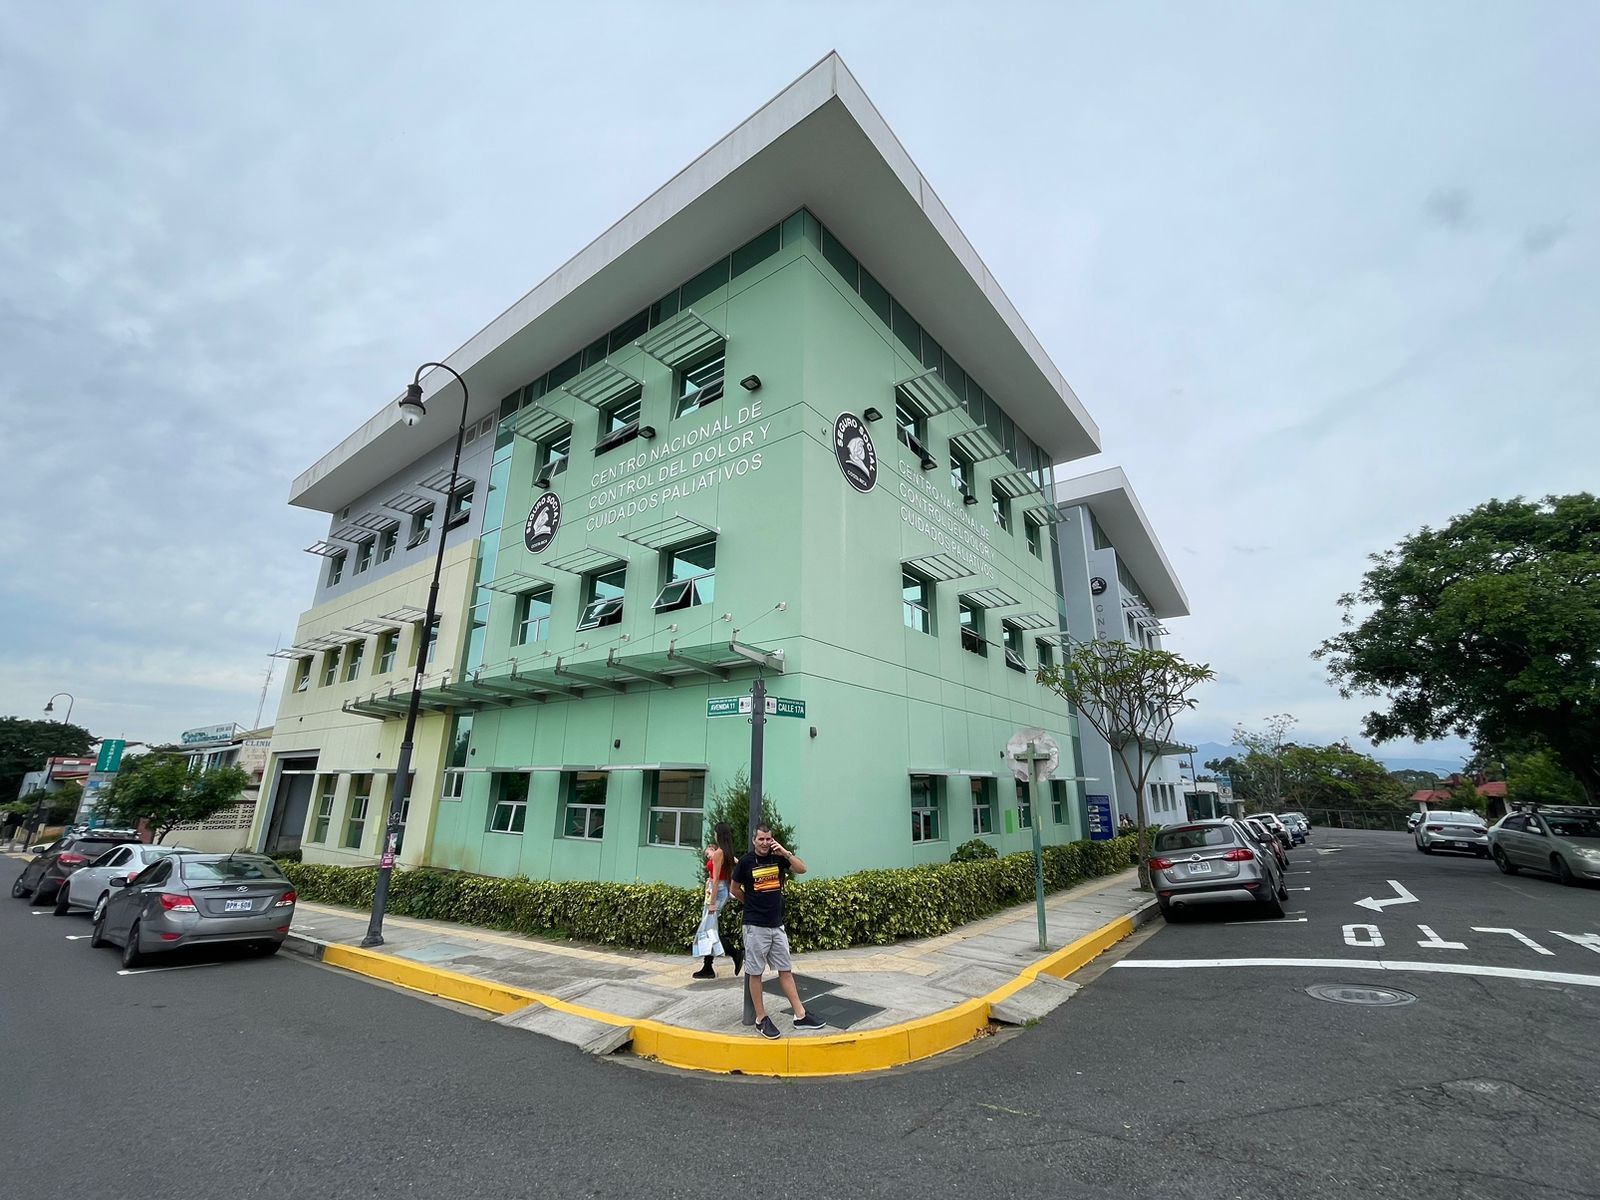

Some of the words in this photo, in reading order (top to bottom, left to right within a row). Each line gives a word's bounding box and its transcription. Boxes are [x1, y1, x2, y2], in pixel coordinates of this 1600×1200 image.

[589, 474, 654, 510] CONTROL
[659, 459, 688, 482] DEL
[692, 430, 754, 468] DOLOR
[759, 422, 771, 441] Y
[592, 453, 647, 488] CENTRO
[650, 415, 732, 462] NACIONAL
[738, 400, 762, 424] DE
[837, 417, 858, 448] SEGURO
[858, 426, 876, 472] SOCIAL
[526, 496, 546, 535] SEGURO
[546, 495, 559, 525] SOCIAL
[586, 493, 658, 532] CUIDADOS
[661, 453, 764, 504] PALIATIVOS
[898, 460, 939, 500] CENTRO
[939, 493, 980, 536] NACIONAL
[980, 525, 990, 541] DE
[899, 482, 946, 528] CONTROL
[947, 518, 963, 539] DEL
[963, 530, 989, 558] DOLOR
[900, 506, 950, 551] CUIDADOS
[950, 541, 994, 580] PALIATIVOS
[710, 703, 730, 711] AVENIDA
[729, 702, 735, 710] 11
[778, 703, 794, 713] CALLE
[794, 705, 804, 714] 17A
